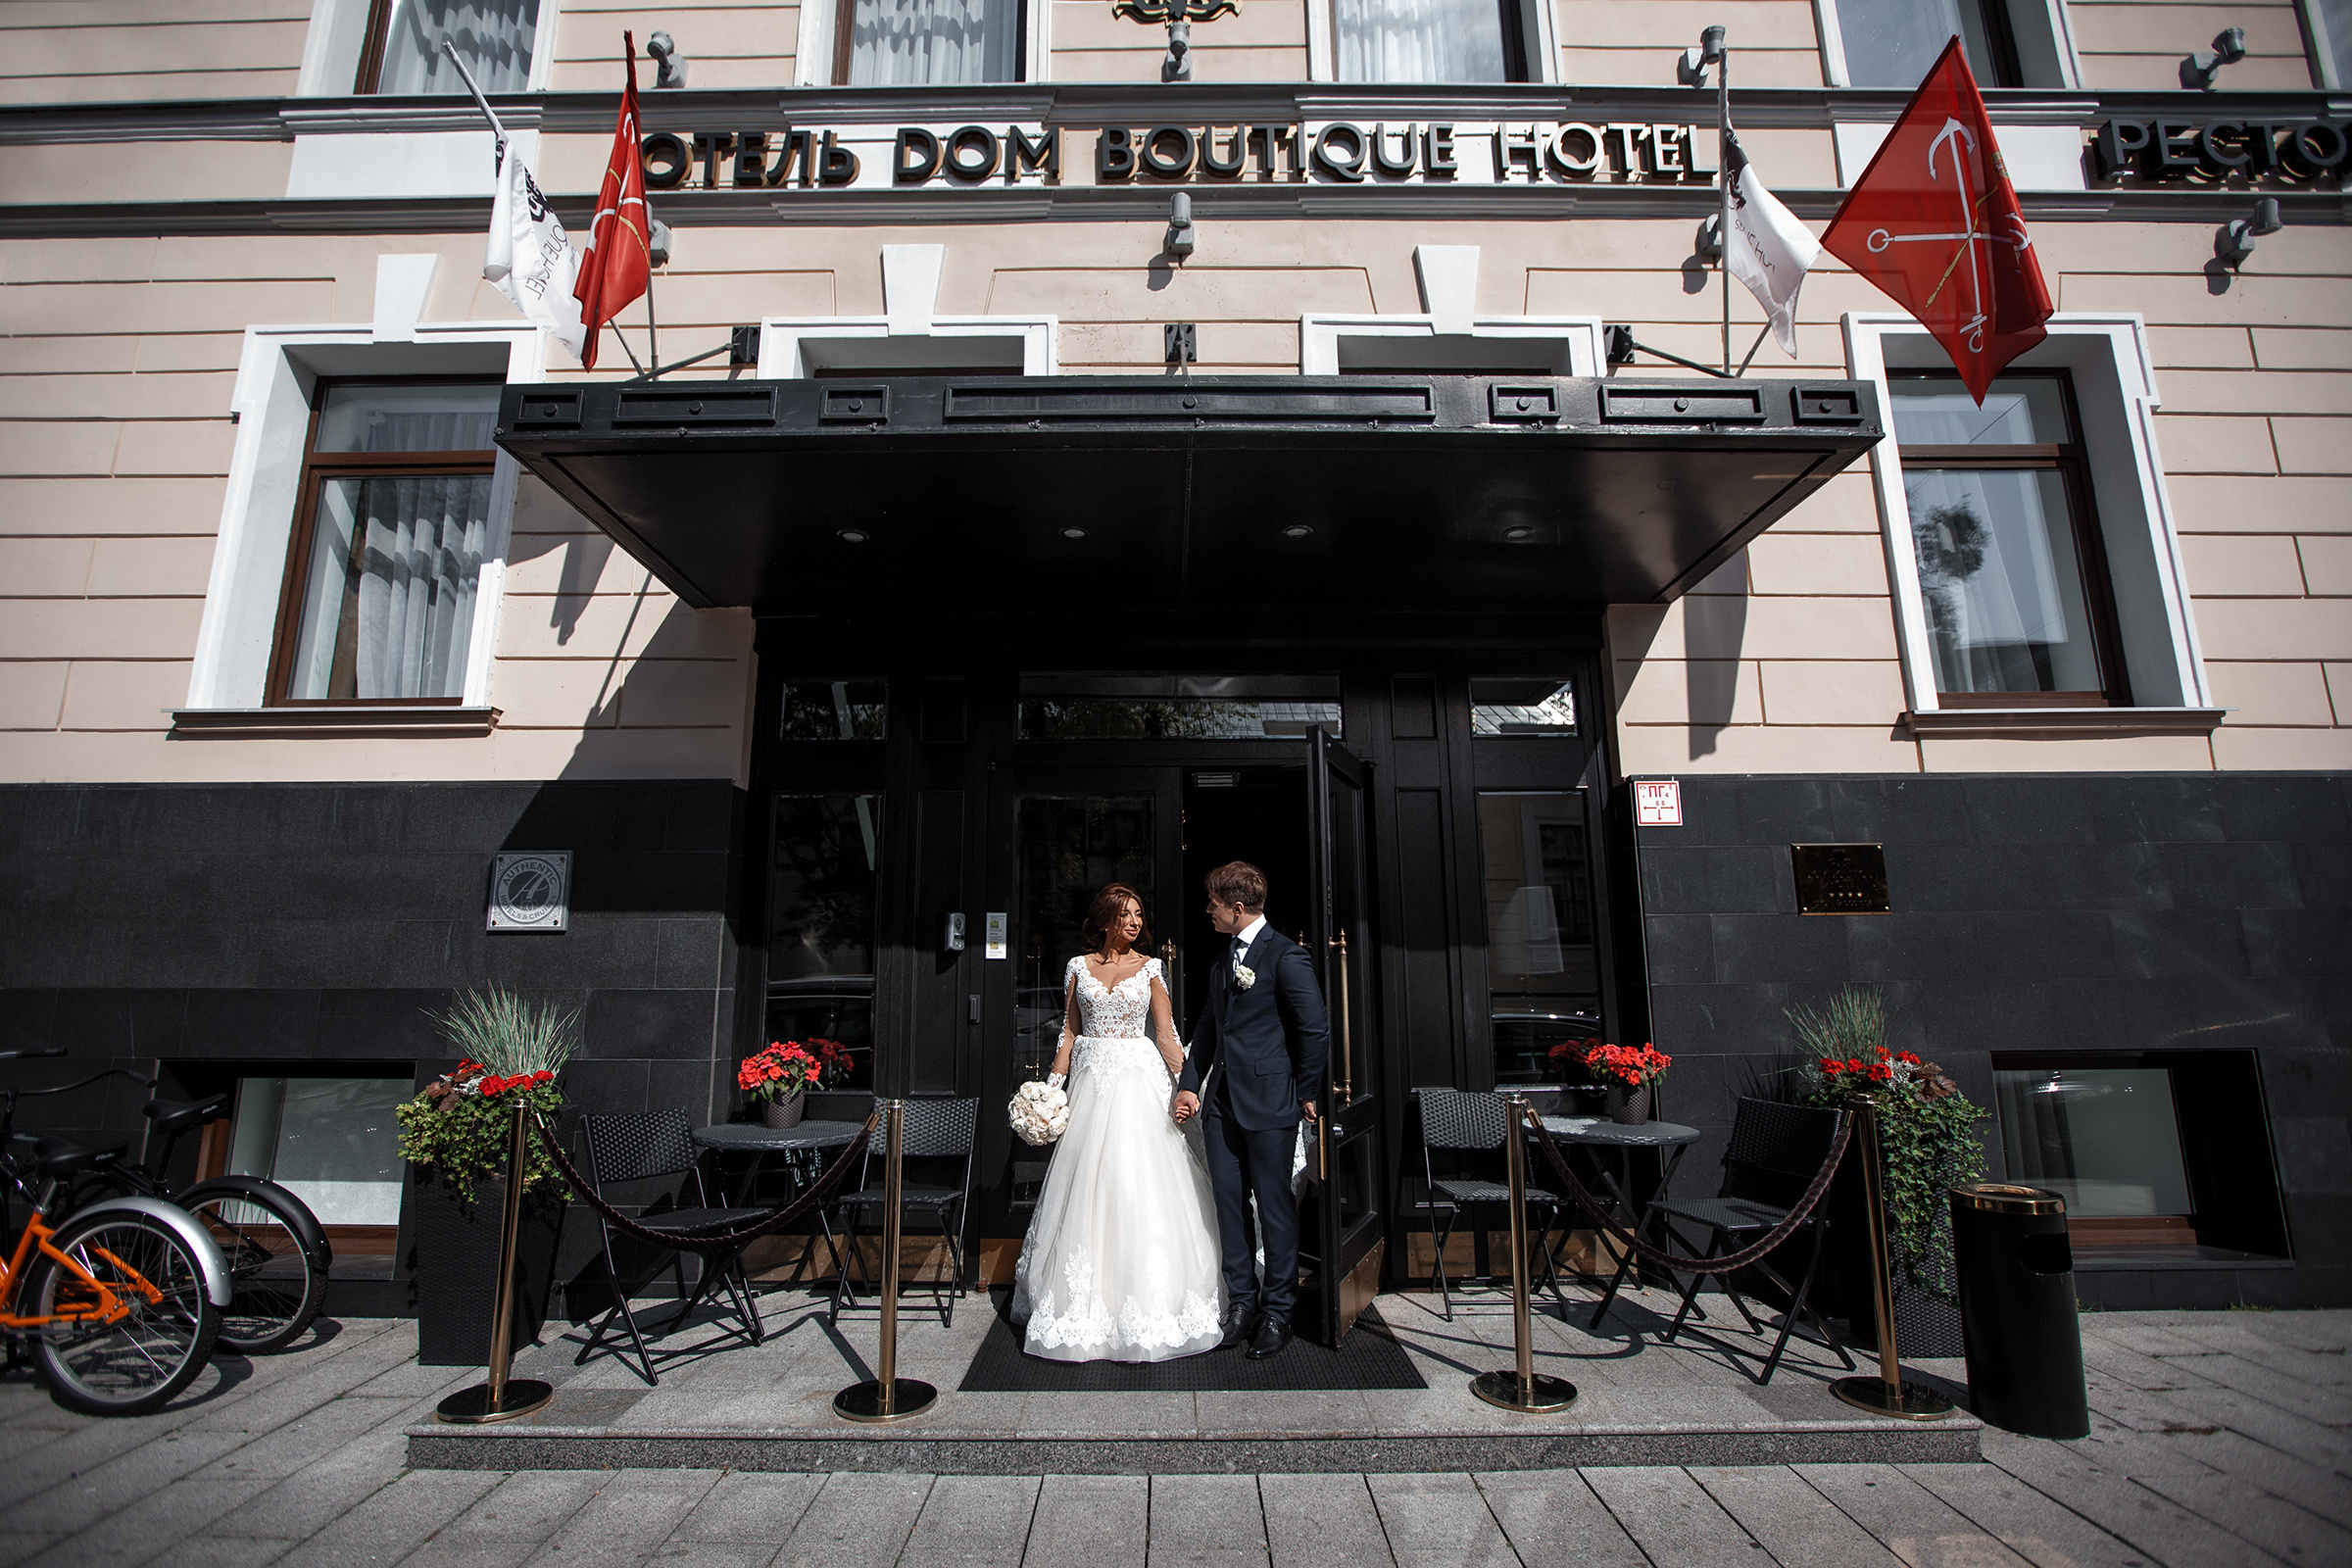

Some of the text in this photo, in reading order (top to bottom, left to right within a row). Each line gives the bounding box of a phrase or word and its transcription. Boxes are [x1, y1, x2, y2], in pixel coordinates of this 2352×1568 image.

[641, 130, 856, 188] ОТЕЛЬ
[896, 122, 1720, 181] DOM BOUTIQUE HOTEL
[1648, 786, 1665, 798] ПГ
[503, 862, 558, 886] AUTHENTIC
[501, 895, 521, 919] HOTELS
[529, 895, 556, 919] CRUISES
